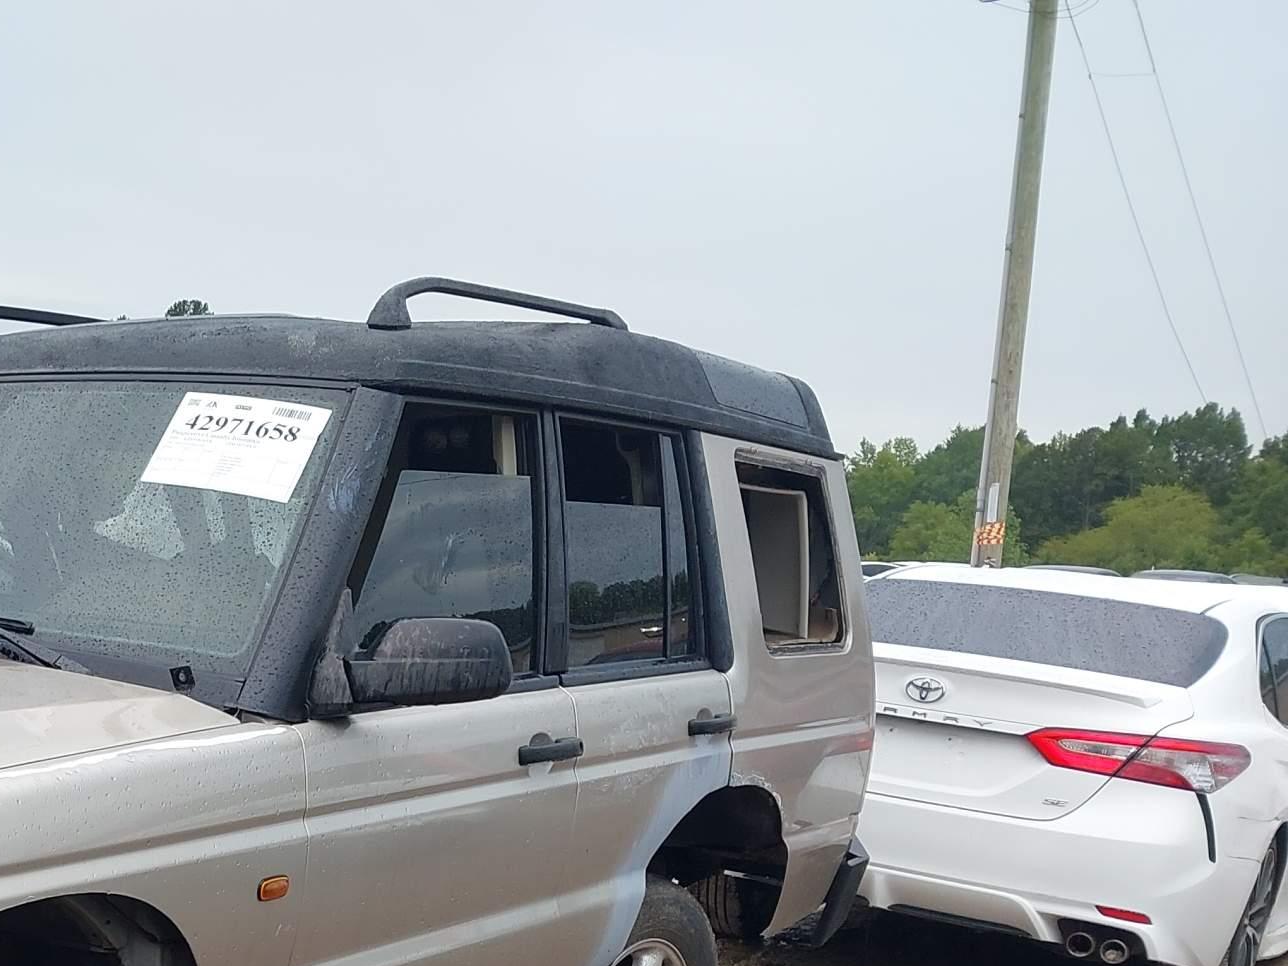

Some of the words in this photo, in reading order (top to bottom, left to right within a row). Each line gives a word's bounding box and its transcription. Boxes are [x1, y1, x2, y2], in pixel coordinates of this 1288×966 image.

[186, 413, 301, 443] 42971658
[883, 706, 993, 727] AMRY
[1042, 798, 1068, 807] SE
